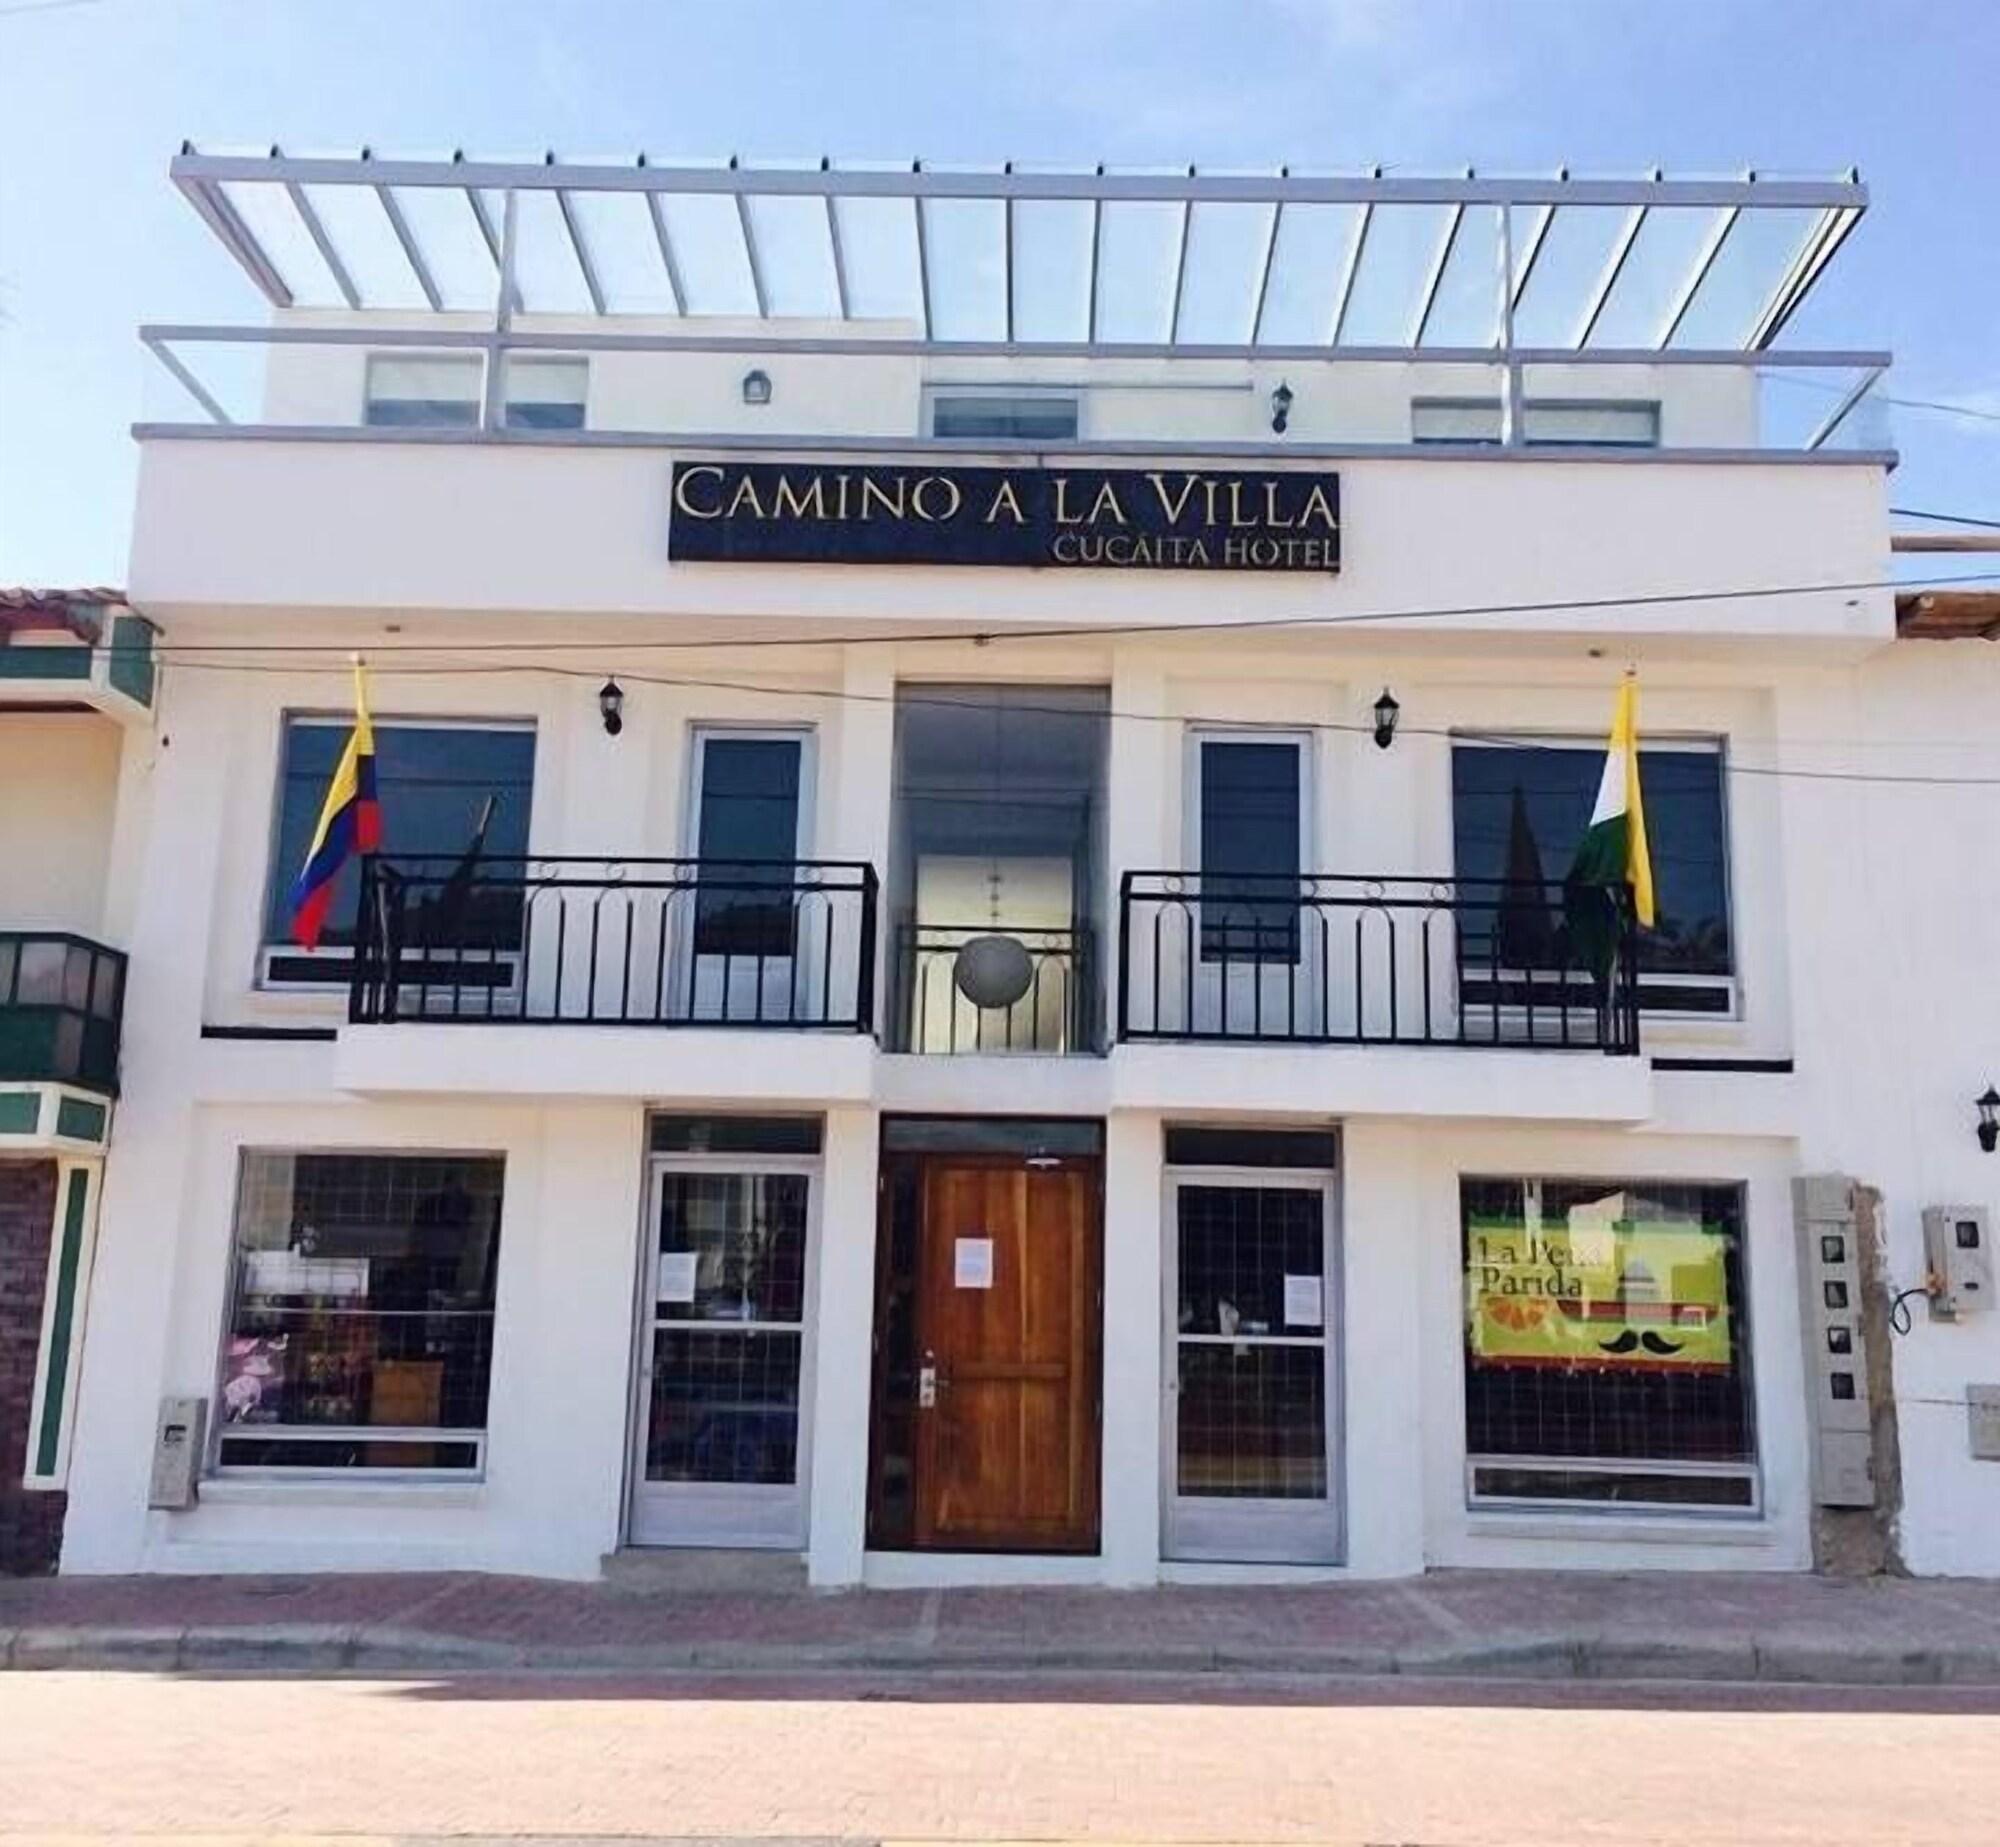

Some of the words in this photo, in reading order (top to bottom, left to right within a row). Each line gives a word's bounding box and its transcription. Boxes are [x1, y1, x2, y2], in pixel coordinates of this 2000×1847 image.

[675, 466, 961, 521] CAMINO
[984, 480, 1026, 523] A
[1053, 478, 1128, 525] LA
[1145, 473, 1340, 530] VILLA
[1053, 534, 1211, 564] CUCAITA
[1224, 537, 1339, 567] HOTEL
[1478, 1236, 1518, 1264] La
[1479, 1266, 1582, 1297] Parida
